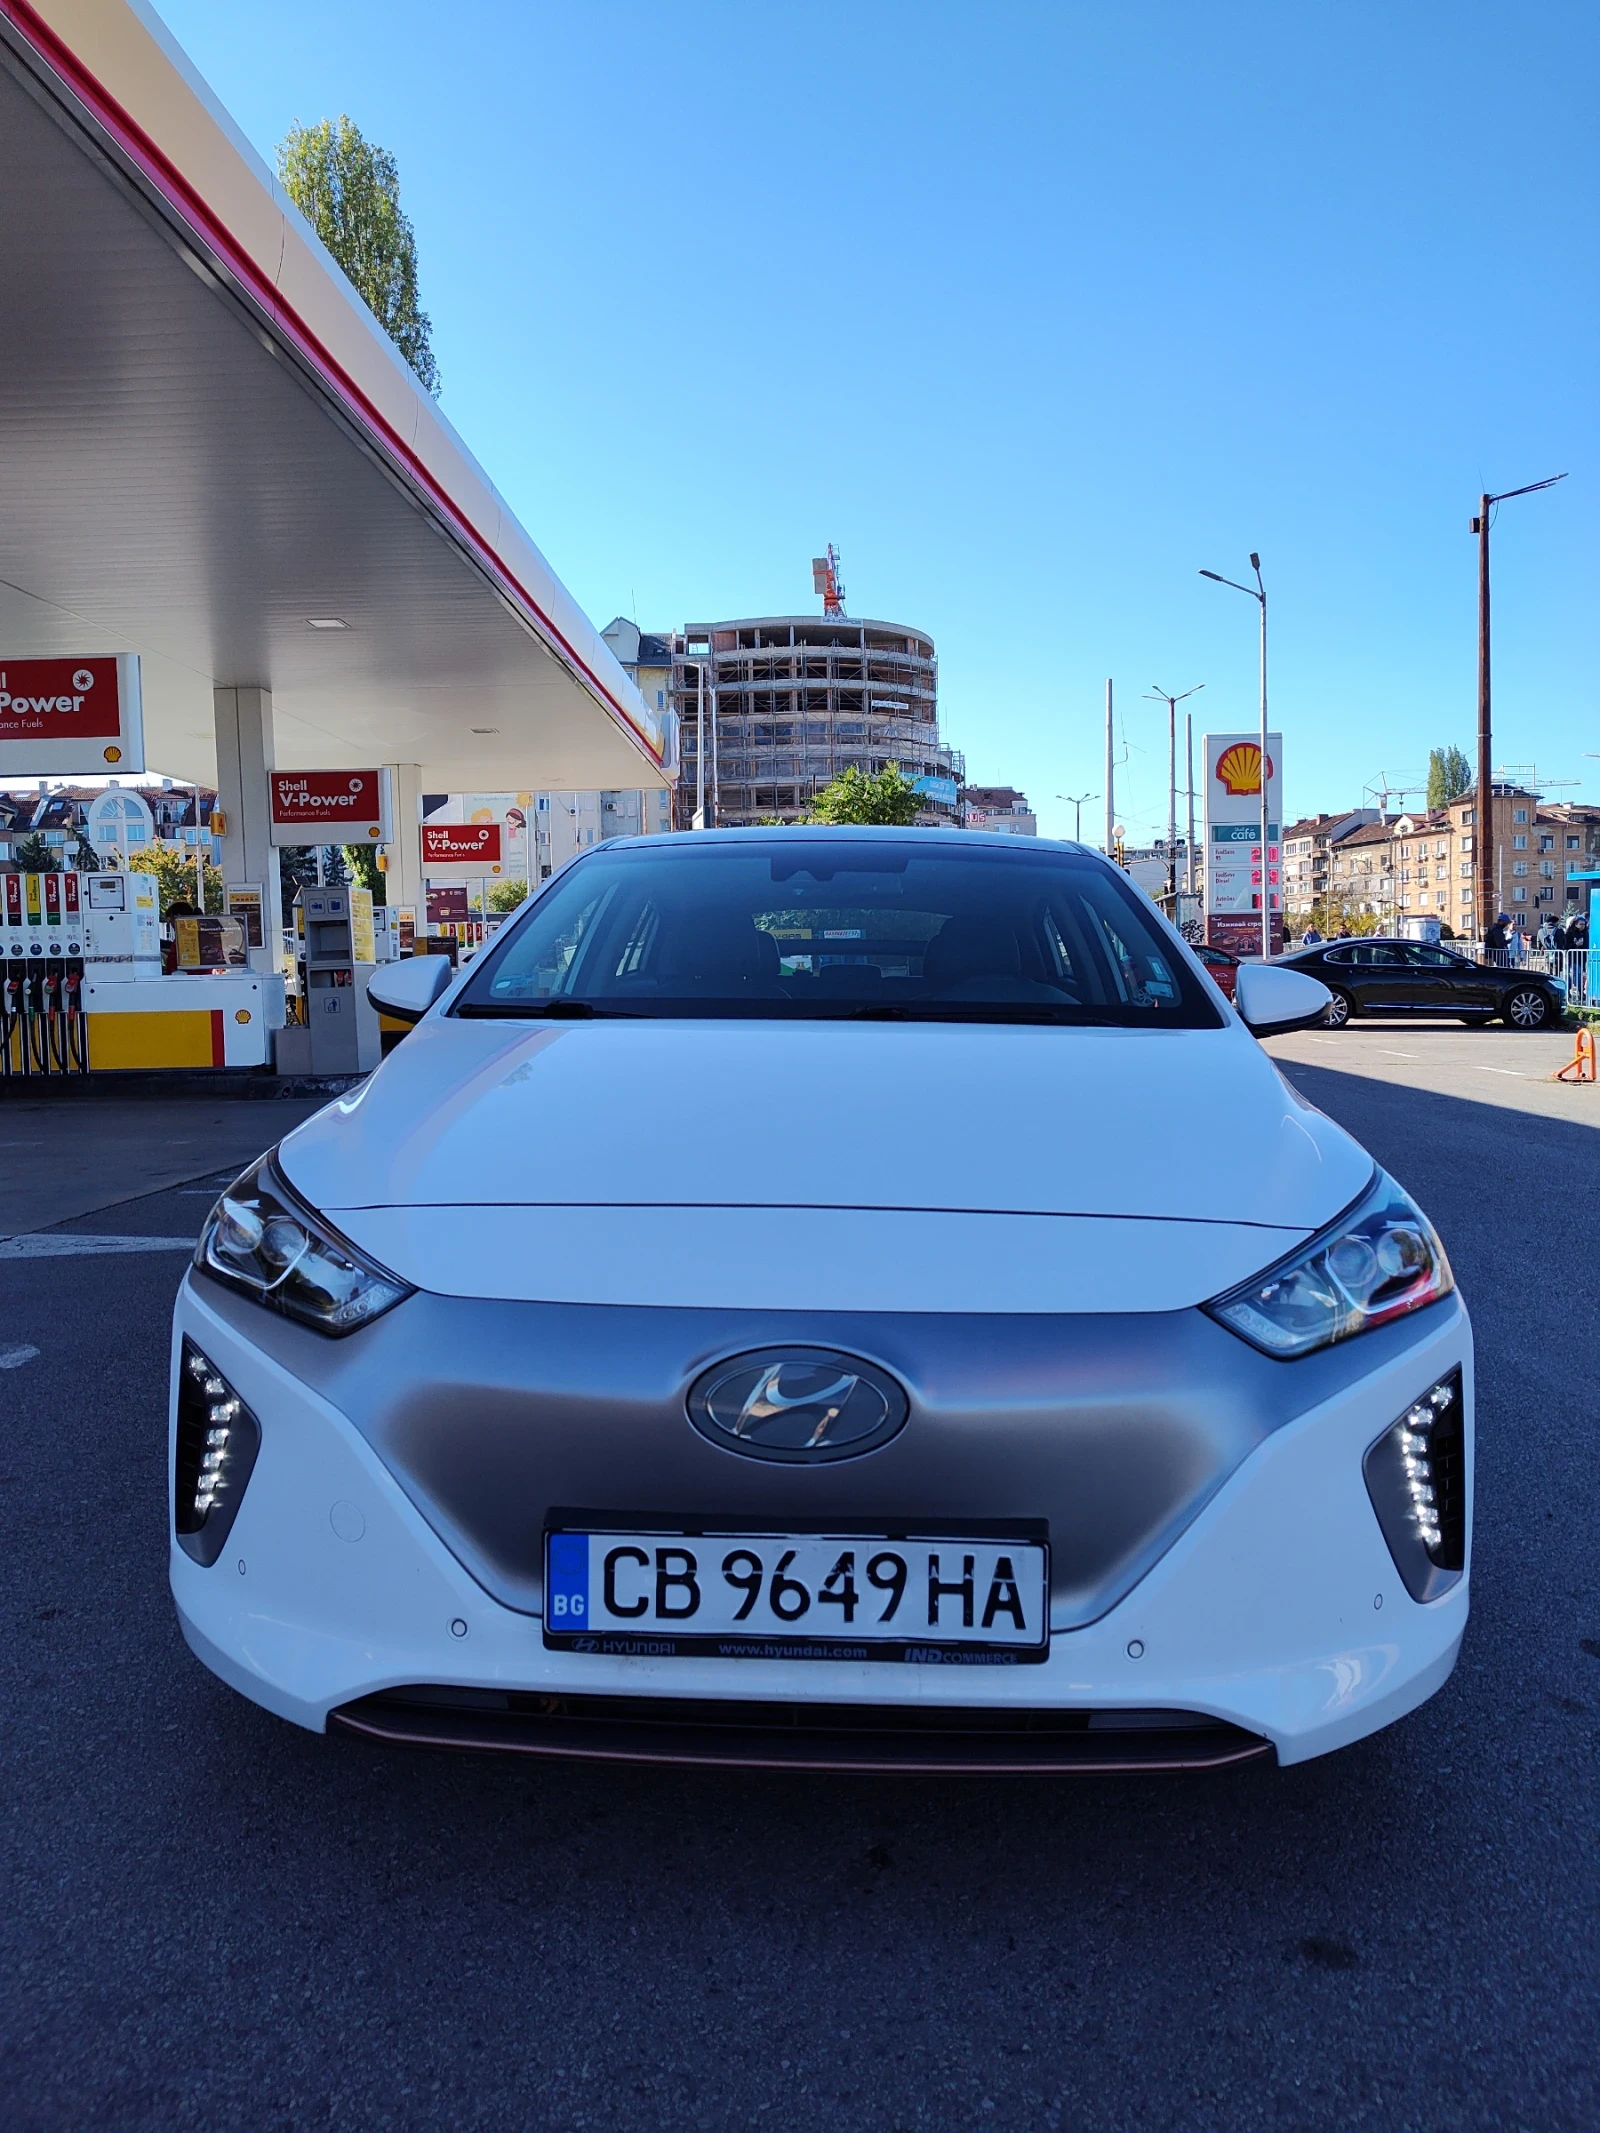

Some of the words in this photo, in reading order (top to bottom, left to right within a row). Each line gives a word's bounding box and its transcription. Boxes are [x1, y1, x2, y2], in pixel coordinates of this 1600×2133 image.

[21, 718, 44, 728] Fuels
[278, 780, 307, 791] Shell
[279, 792, 358, 807] V-Power
[279, 809, 315, 817] Performance
[316, 808, 331, 816] Fuels
[427, 830, 449, 839] Shell
[1231, 828, 1256, 840] café
[427, 840, 485, 851] V-Power
[604, 1546, 701, 1619] CB
[722, 1549, 907, 1623] 9649
[928, 1554, 1026, 1630] HA
[554, 1594, 585, 1616] BG
[602, 1640, 675, 1654] HYUNDAI
[718, 1643, 867, 1659] www.hyundai.com
